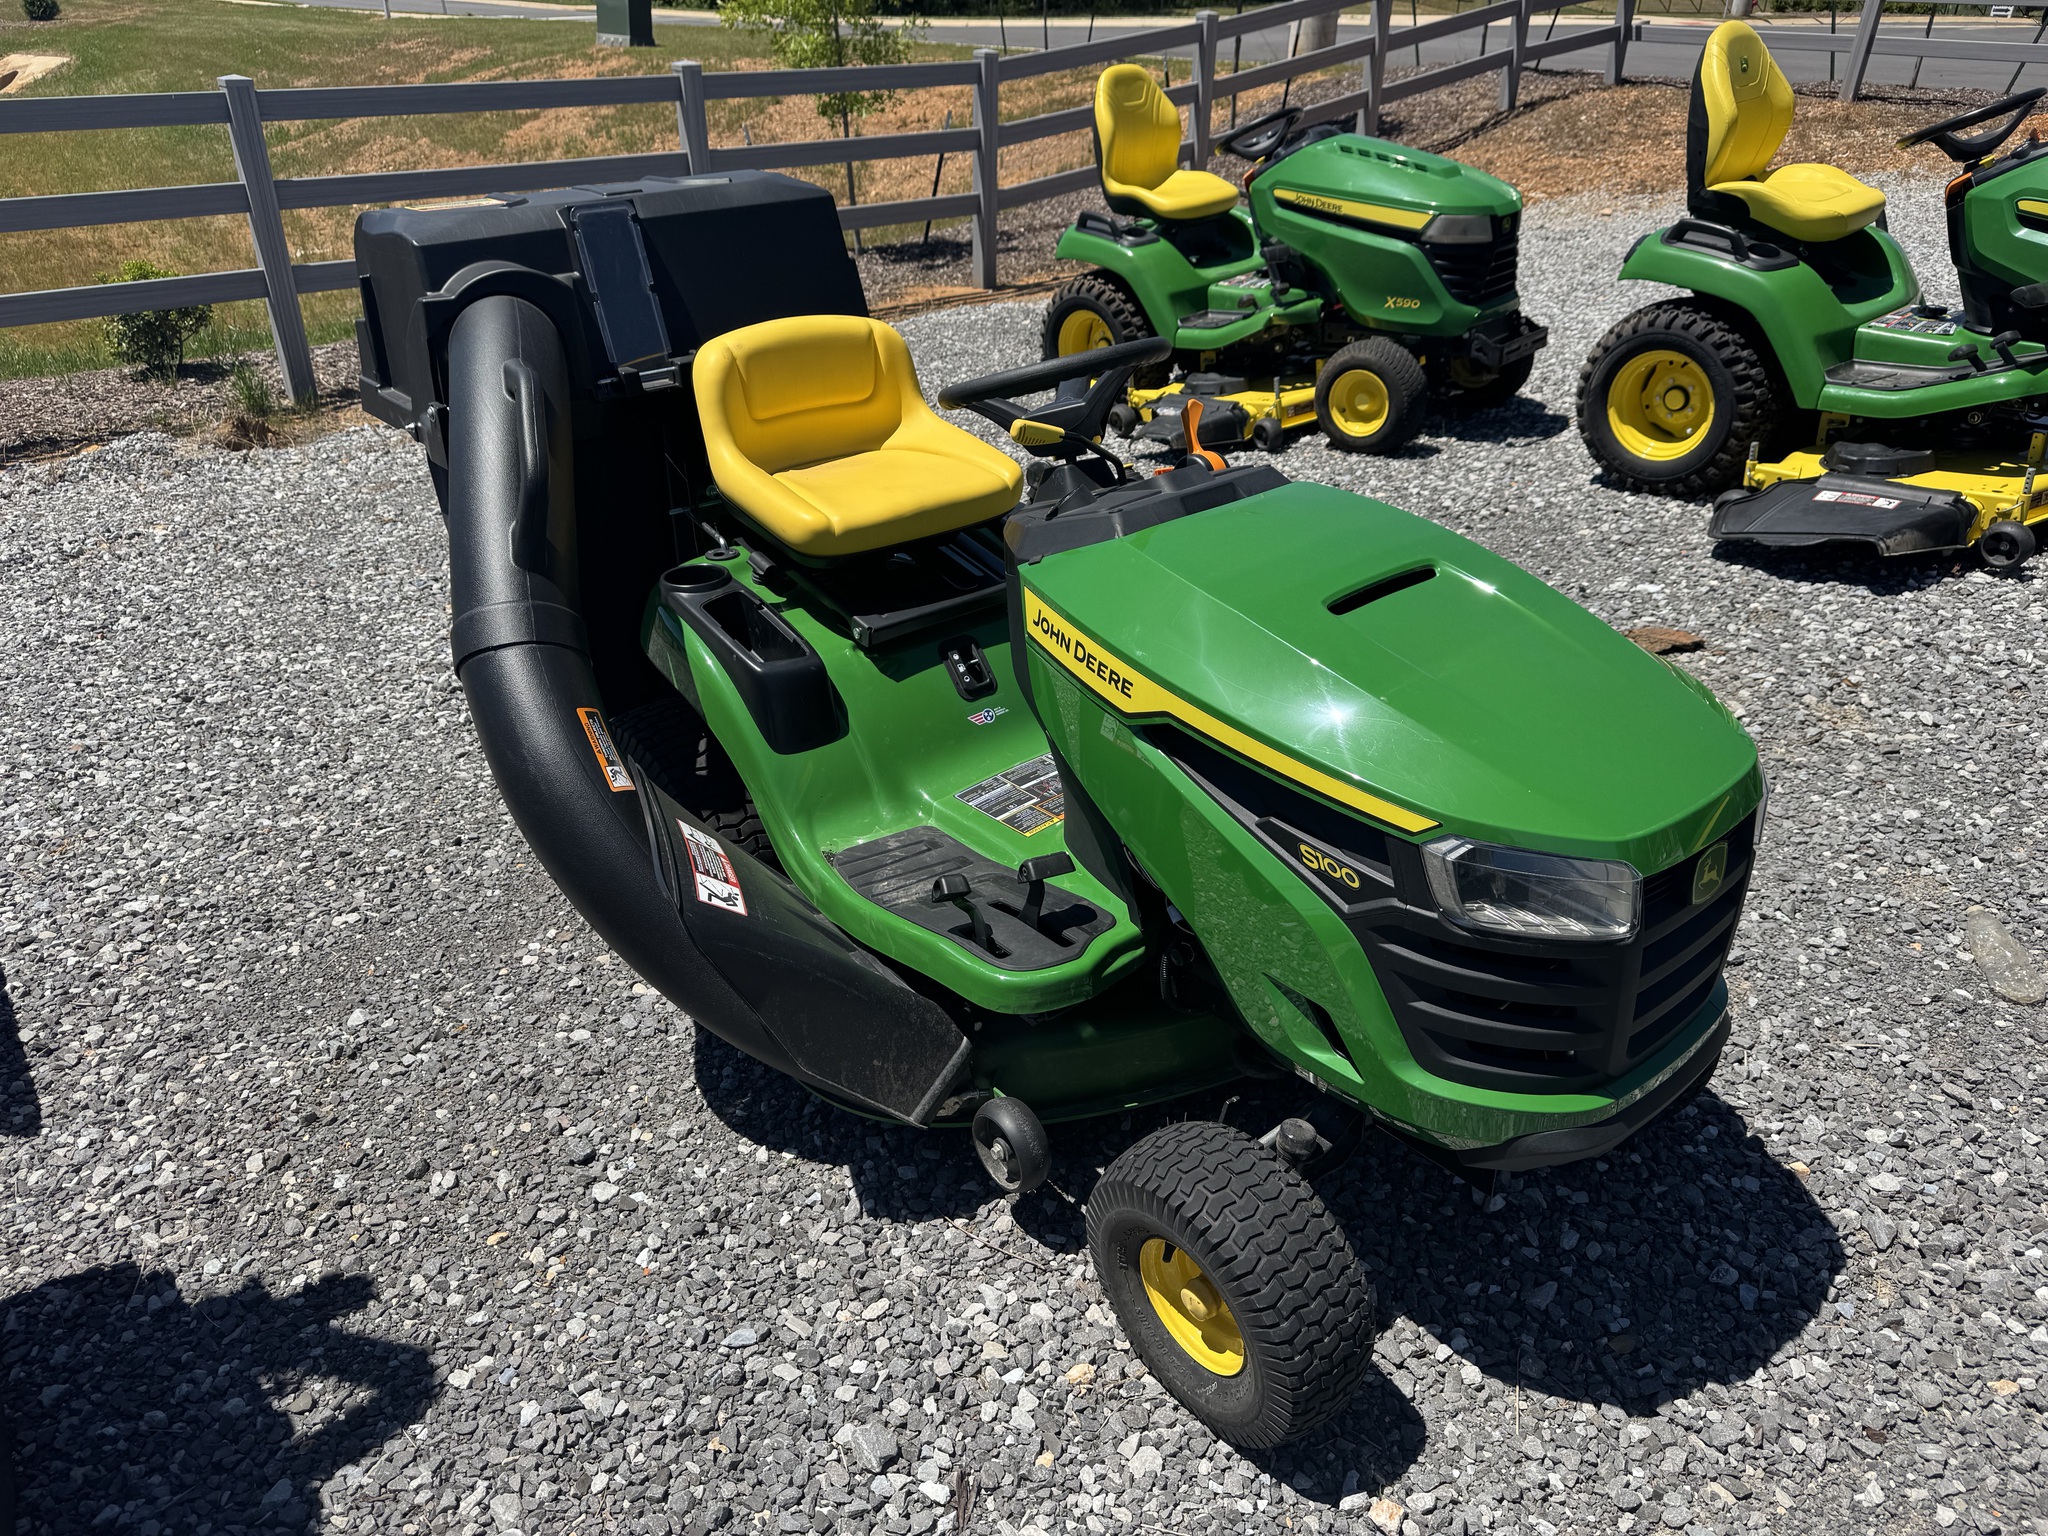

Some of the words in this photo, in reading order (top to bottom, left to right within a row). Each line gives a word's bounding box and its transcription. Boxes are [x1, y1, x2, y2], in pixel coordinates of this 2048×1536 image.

[1295, 192, 1315, 207] JOHN
[1316, 197, 1343, 213] DEERE
[1384, 296, 1420, 308] X590
[1032, 609, 1071, 653] JOHN
[1073, 639, 1134, 699] DEERE
[1299, 844, 1360, 889] S100
